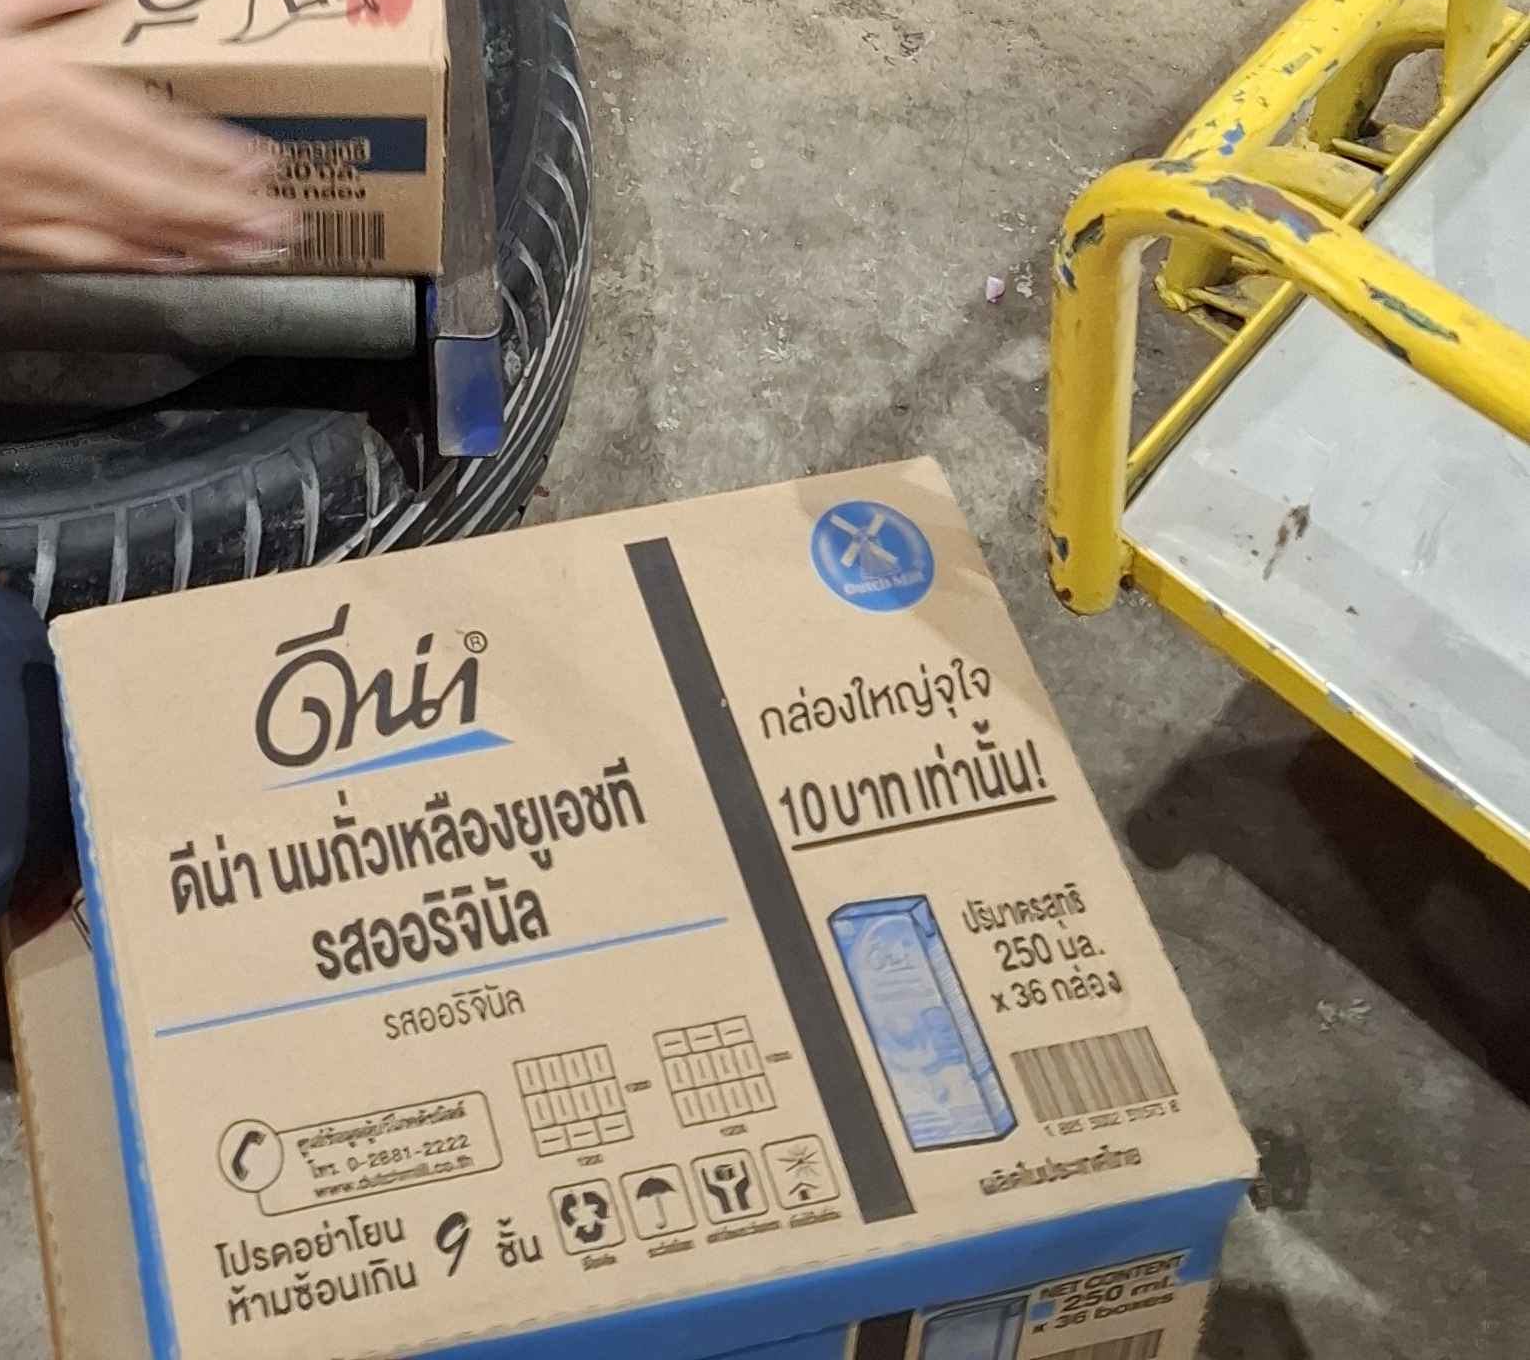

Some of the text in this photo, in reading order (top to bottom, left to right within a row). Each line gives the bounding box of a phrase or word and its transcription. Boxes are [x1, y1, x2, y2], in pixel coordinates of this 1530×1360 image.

[759, 657, 992, 739] กล่องใหญ่จุใจ
[169, 756, 648, 915] ดีน่า นมถั่วเหลืองยูเอชที
[312, 876, 551, 982] รสออริจินัล
[962, 882, 1087, 934] ปริมาตรสุทธิ
[994, 932, 1106, 972] 250 มล.
[383, 984, 526, 1041] รสออริจินัล
[990, 965, 1124, 1014] x 36 กล่อง
[215, 1213, 406, 1279] โปรดอย่าโยน
[228, 1210, 544, 1326] ห้ามซ้อนเกิน 9 ชั้น
[1053, 1308, 1088, 1330] 36
[1093, 1292, 1174, 1320] boxes
[1061, 1283, 1123, 1312] 250
